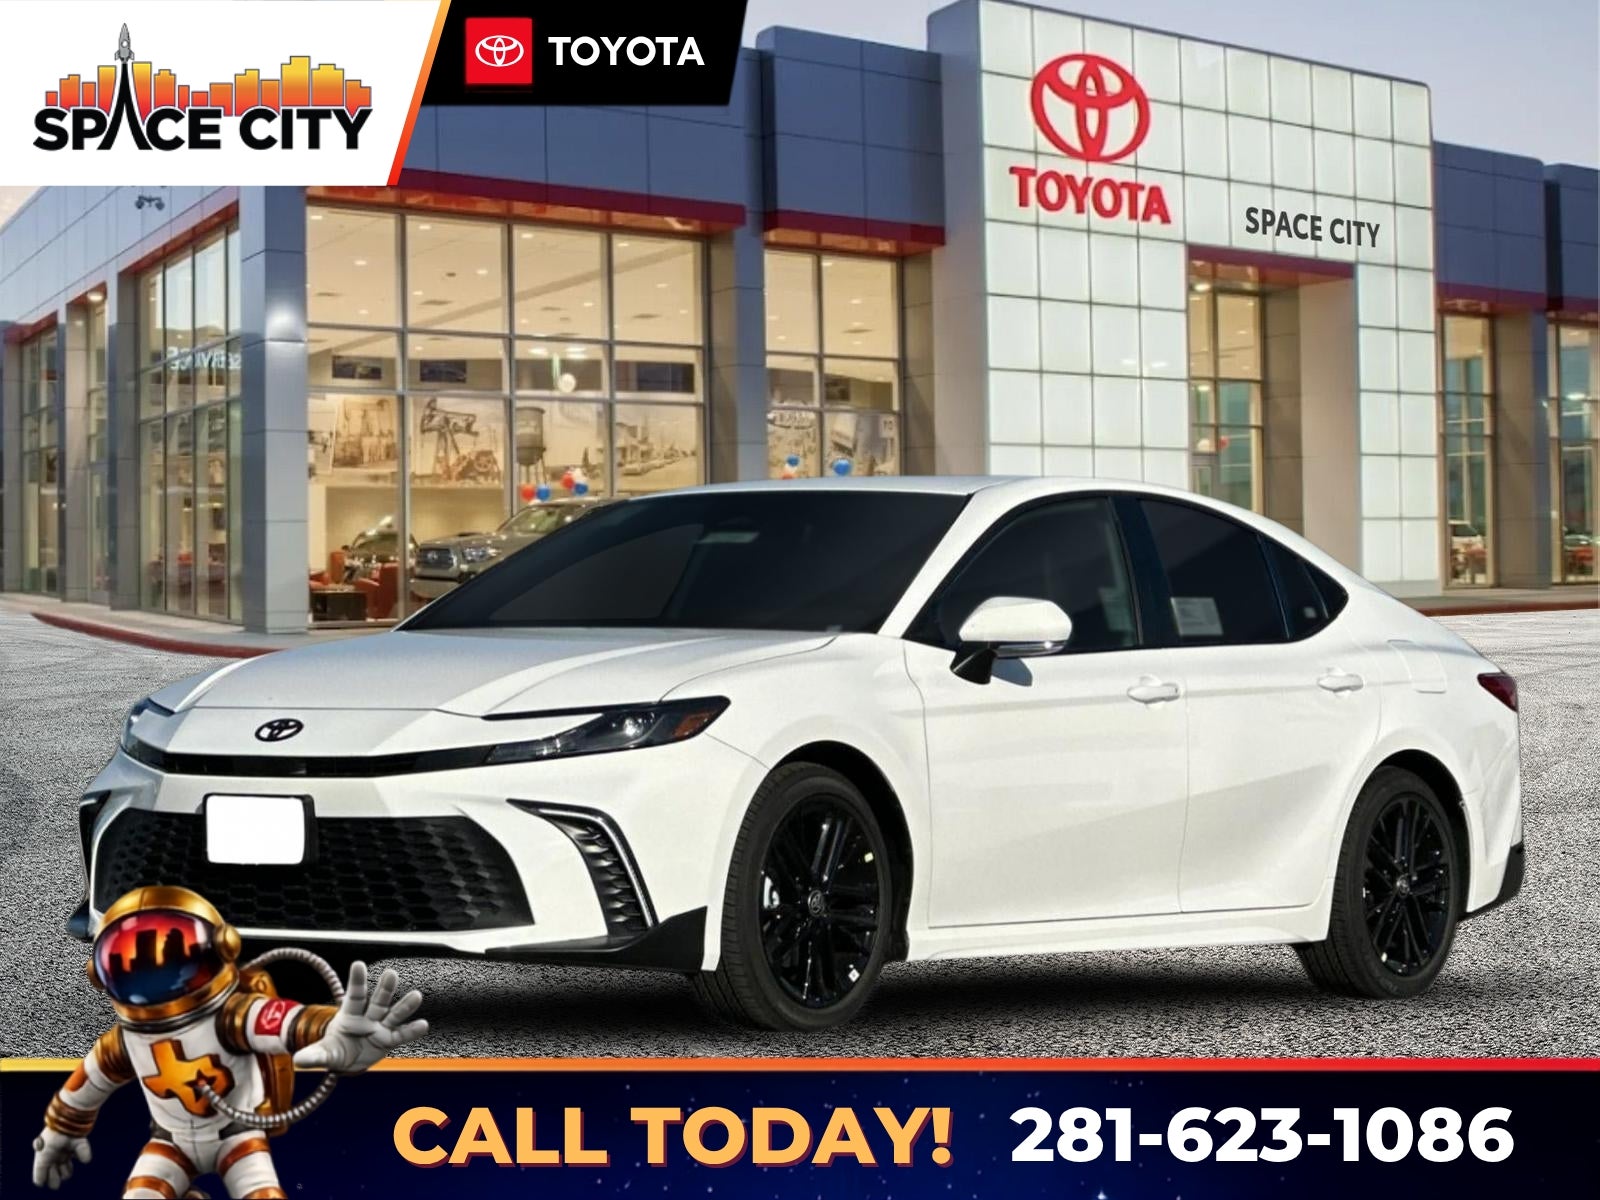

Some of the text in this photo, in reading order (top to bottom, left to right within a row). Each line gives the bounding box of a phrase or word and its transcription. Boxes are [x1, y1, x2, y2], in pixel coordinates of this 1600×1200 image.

[1008, 166, 1171, 225] TOYOTA
[1245, 206, 1381, 248] SPACE CITY
